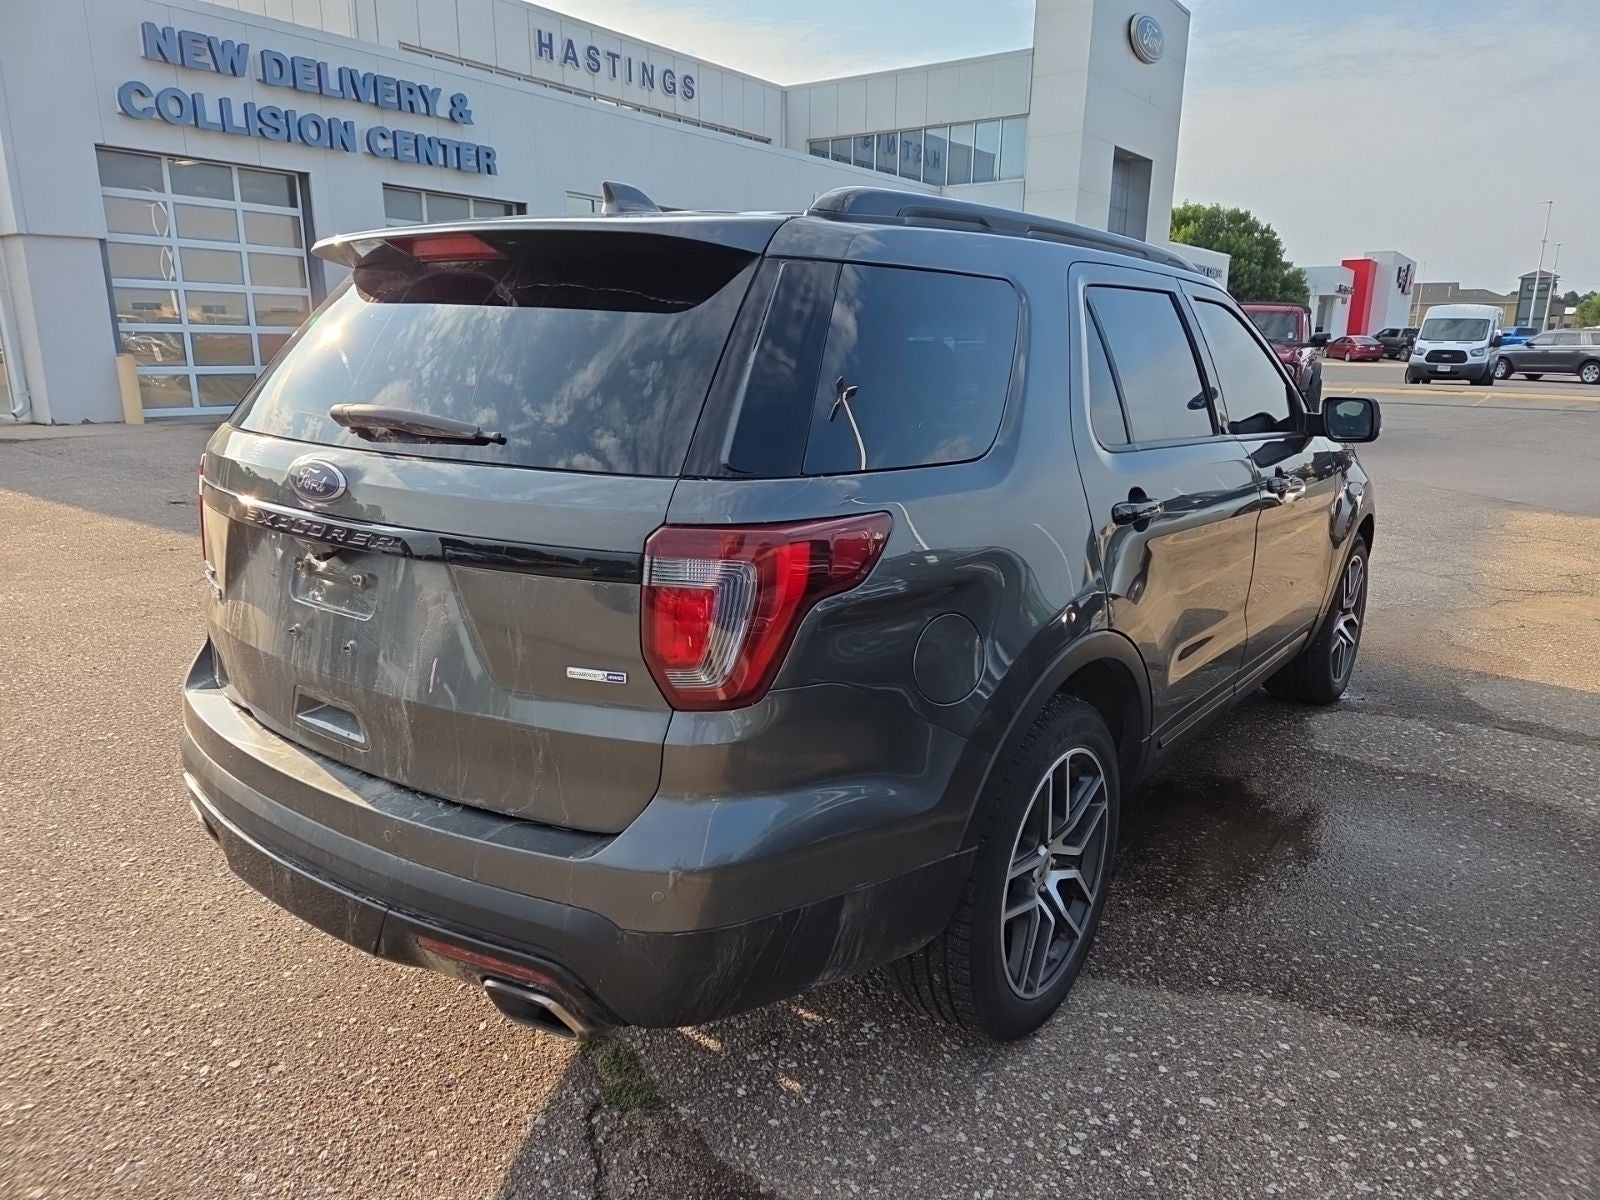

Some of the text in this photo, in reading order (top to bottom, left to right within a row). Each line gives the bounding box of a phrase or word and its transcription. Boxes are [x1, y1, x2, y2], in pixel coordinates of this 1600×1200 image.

[141, 21, 474, 125] NEW DELIVERY &
[536, 28, 696, 101] HASTINGS
[117, 80, 498, 176] COLLISION CENTER
[296, 465, 328, 493] Ford
[244, 508, 397, 550] EXPLORER
